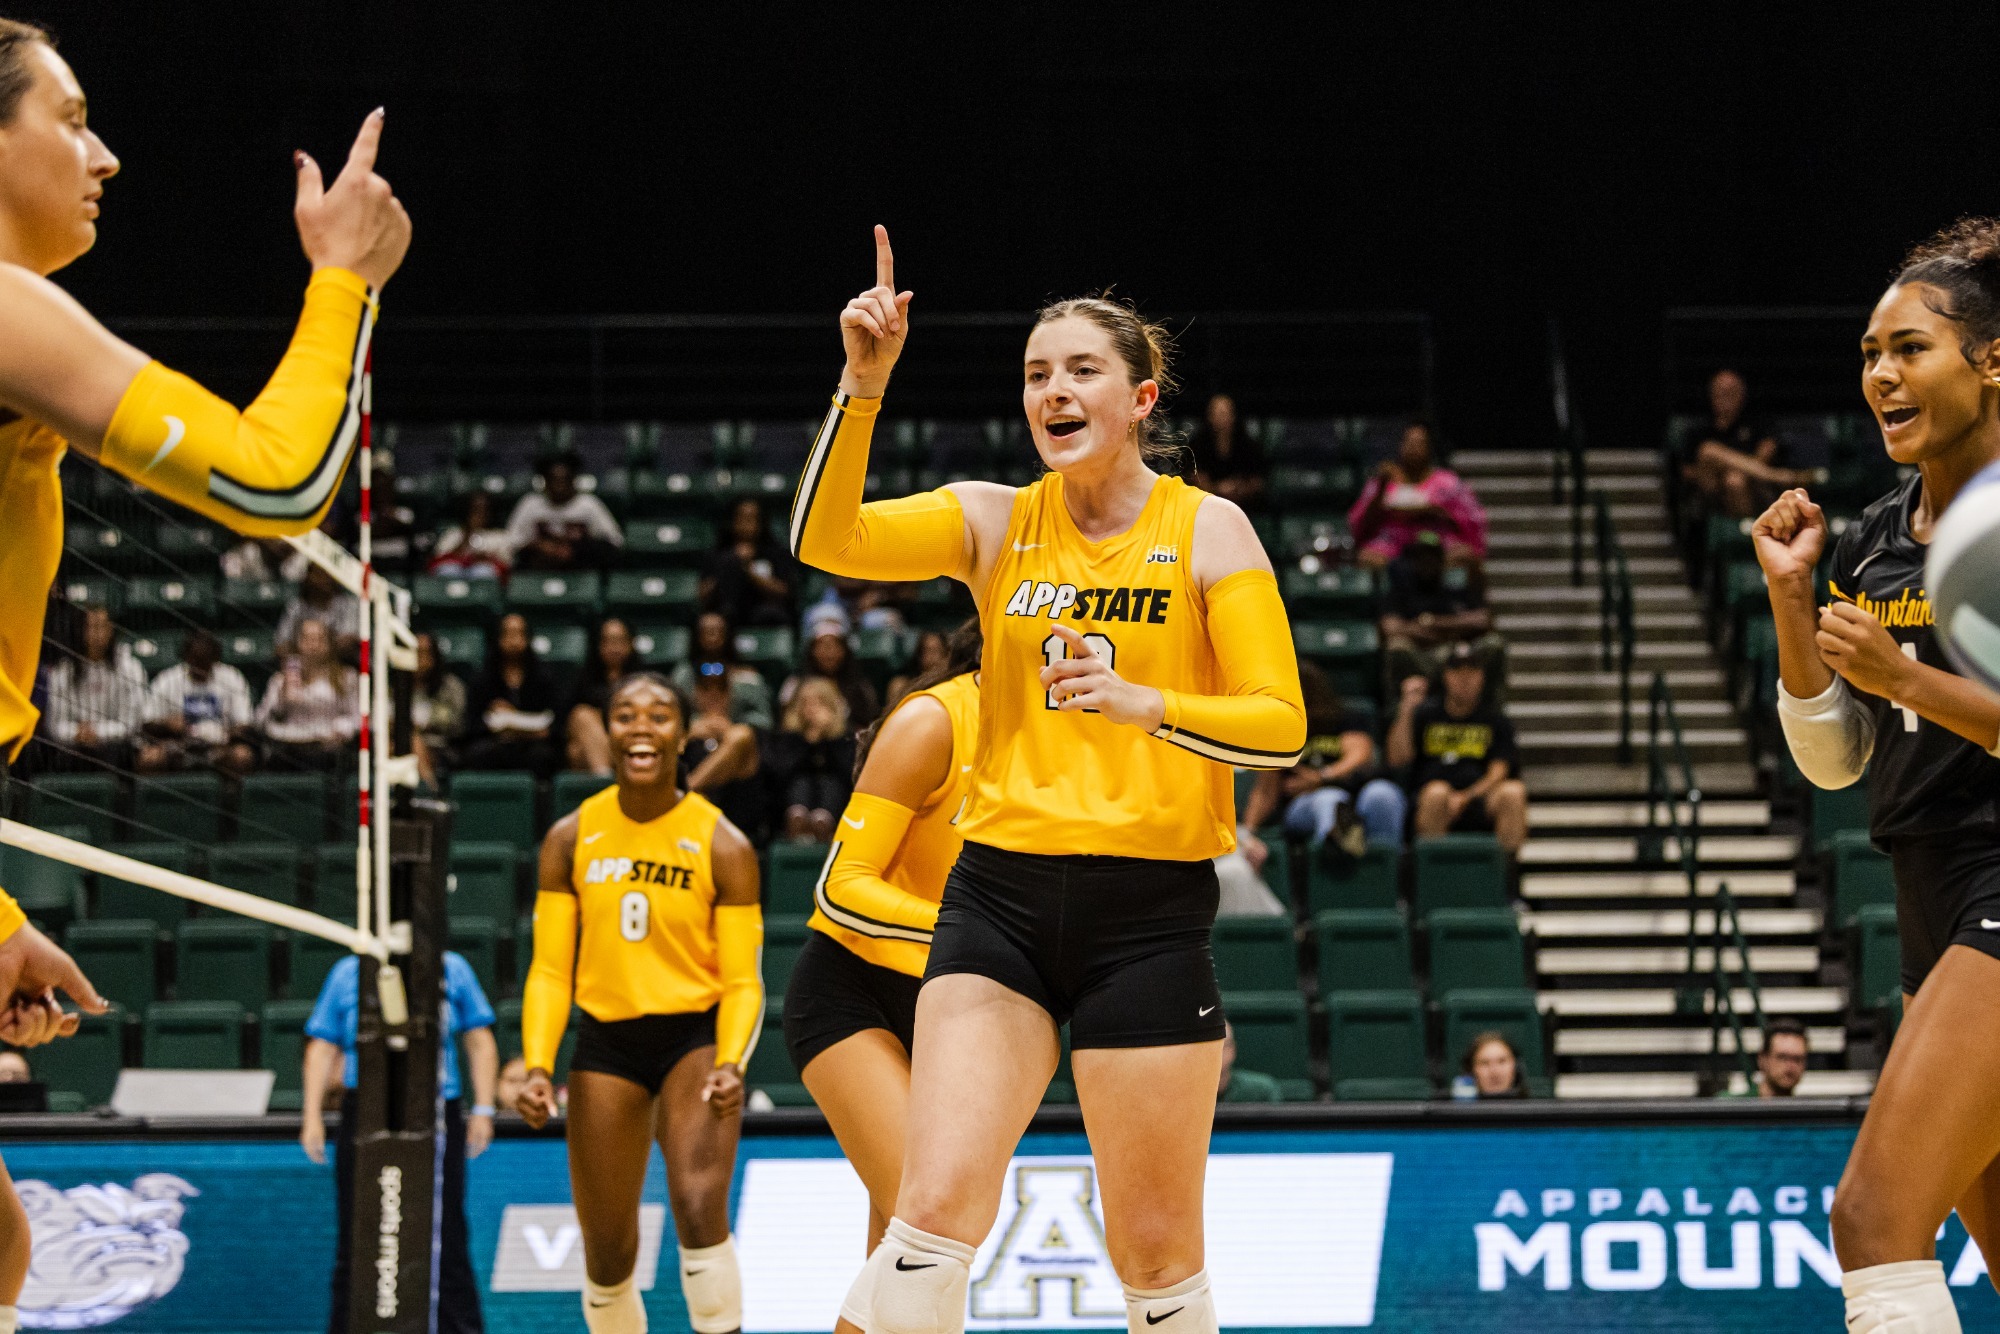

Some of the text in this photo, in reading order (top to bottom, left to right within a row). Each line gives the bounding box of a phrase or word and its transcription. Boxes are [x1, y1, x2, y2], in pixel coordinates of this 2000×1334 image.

[620, 891, 649, 942] 8
[522, 1224, 582, 1271] V
[1474, 1220, 1988, 1291] MOUN
